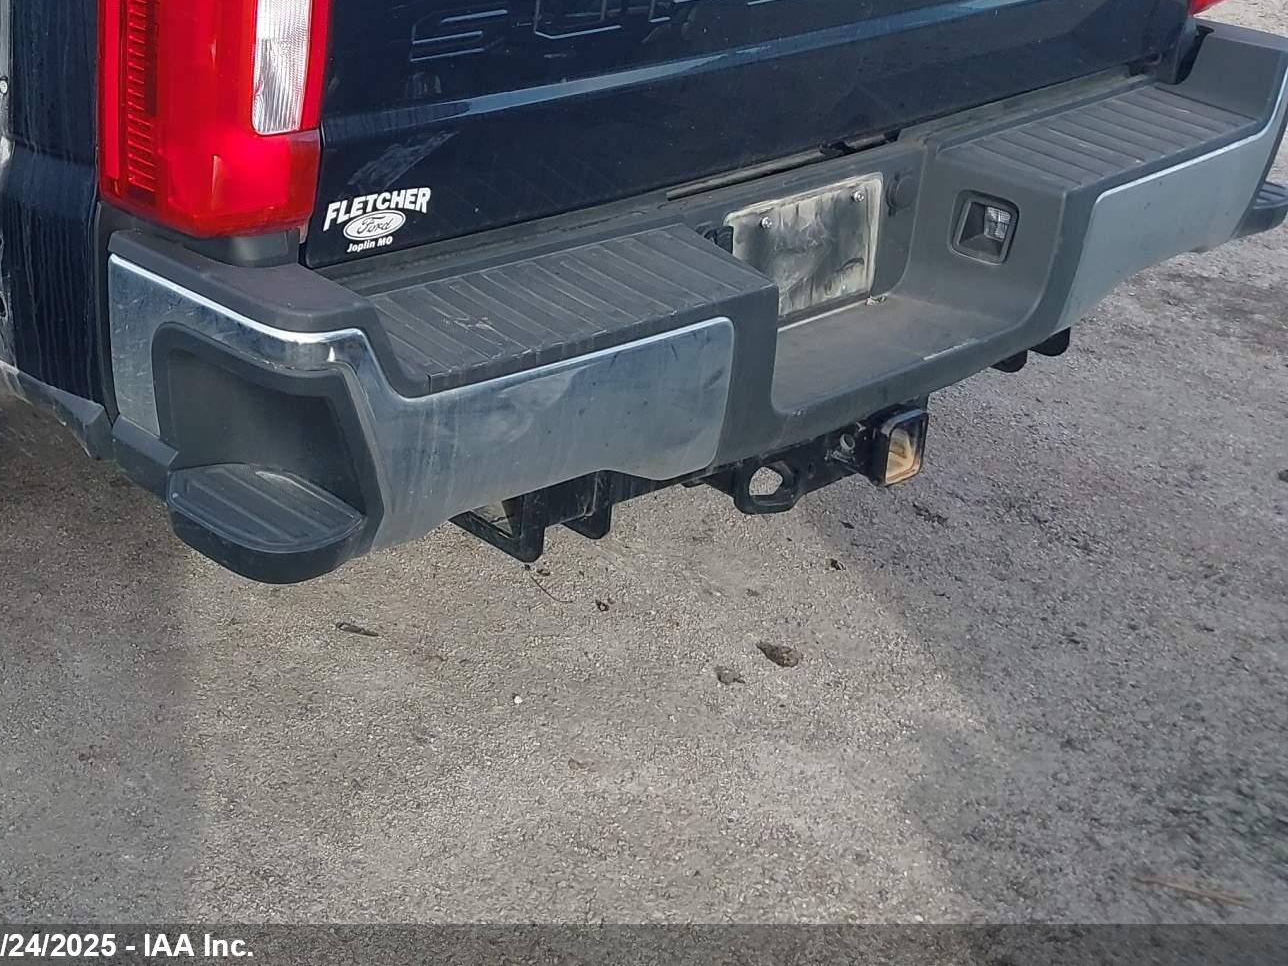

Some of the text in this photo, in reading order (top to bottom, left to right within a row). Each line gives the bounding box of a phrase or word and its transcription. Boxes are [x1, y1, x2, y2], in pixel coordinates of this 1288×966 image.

[322, 186, 432, 232] FLETCHER
[356, 215, 394, 235] Ford
[347, 235, 393, 253] Joplin MO
